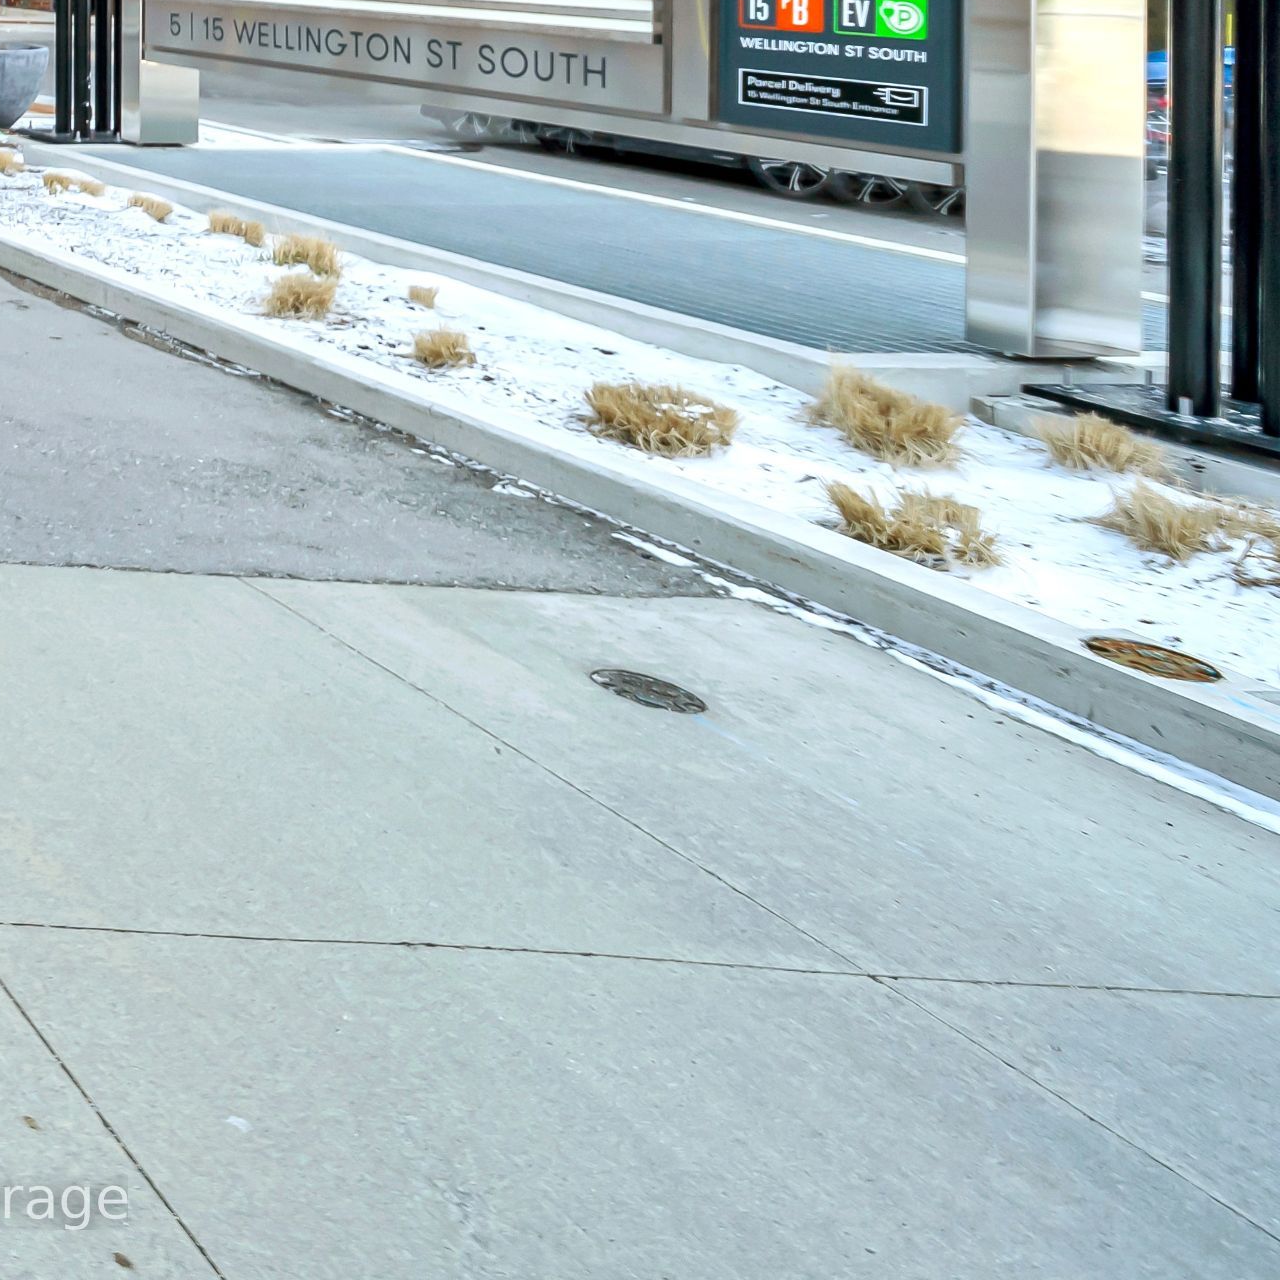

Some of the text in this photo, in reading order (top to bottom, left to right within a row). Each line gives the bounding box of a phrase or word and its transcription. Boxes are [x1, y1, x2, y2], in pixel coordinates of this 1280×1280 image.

[169, 12, 182, 36] 5
[202, 16, 224, 42] 15
[233, 19, 412, 64] WELLINGTON
[426, 38, 463, 70] ST
[477, 43, 607, 89] SOUTH
[739, 36, 928, 63] WELLINGTON ST SOUTH
[747, 75, 841, 98] Parcel Delivery
[759, 90, 807, 104] Wellington
[822, 98, 850, 110] South
[852, 101, 900, 115] Entrance
